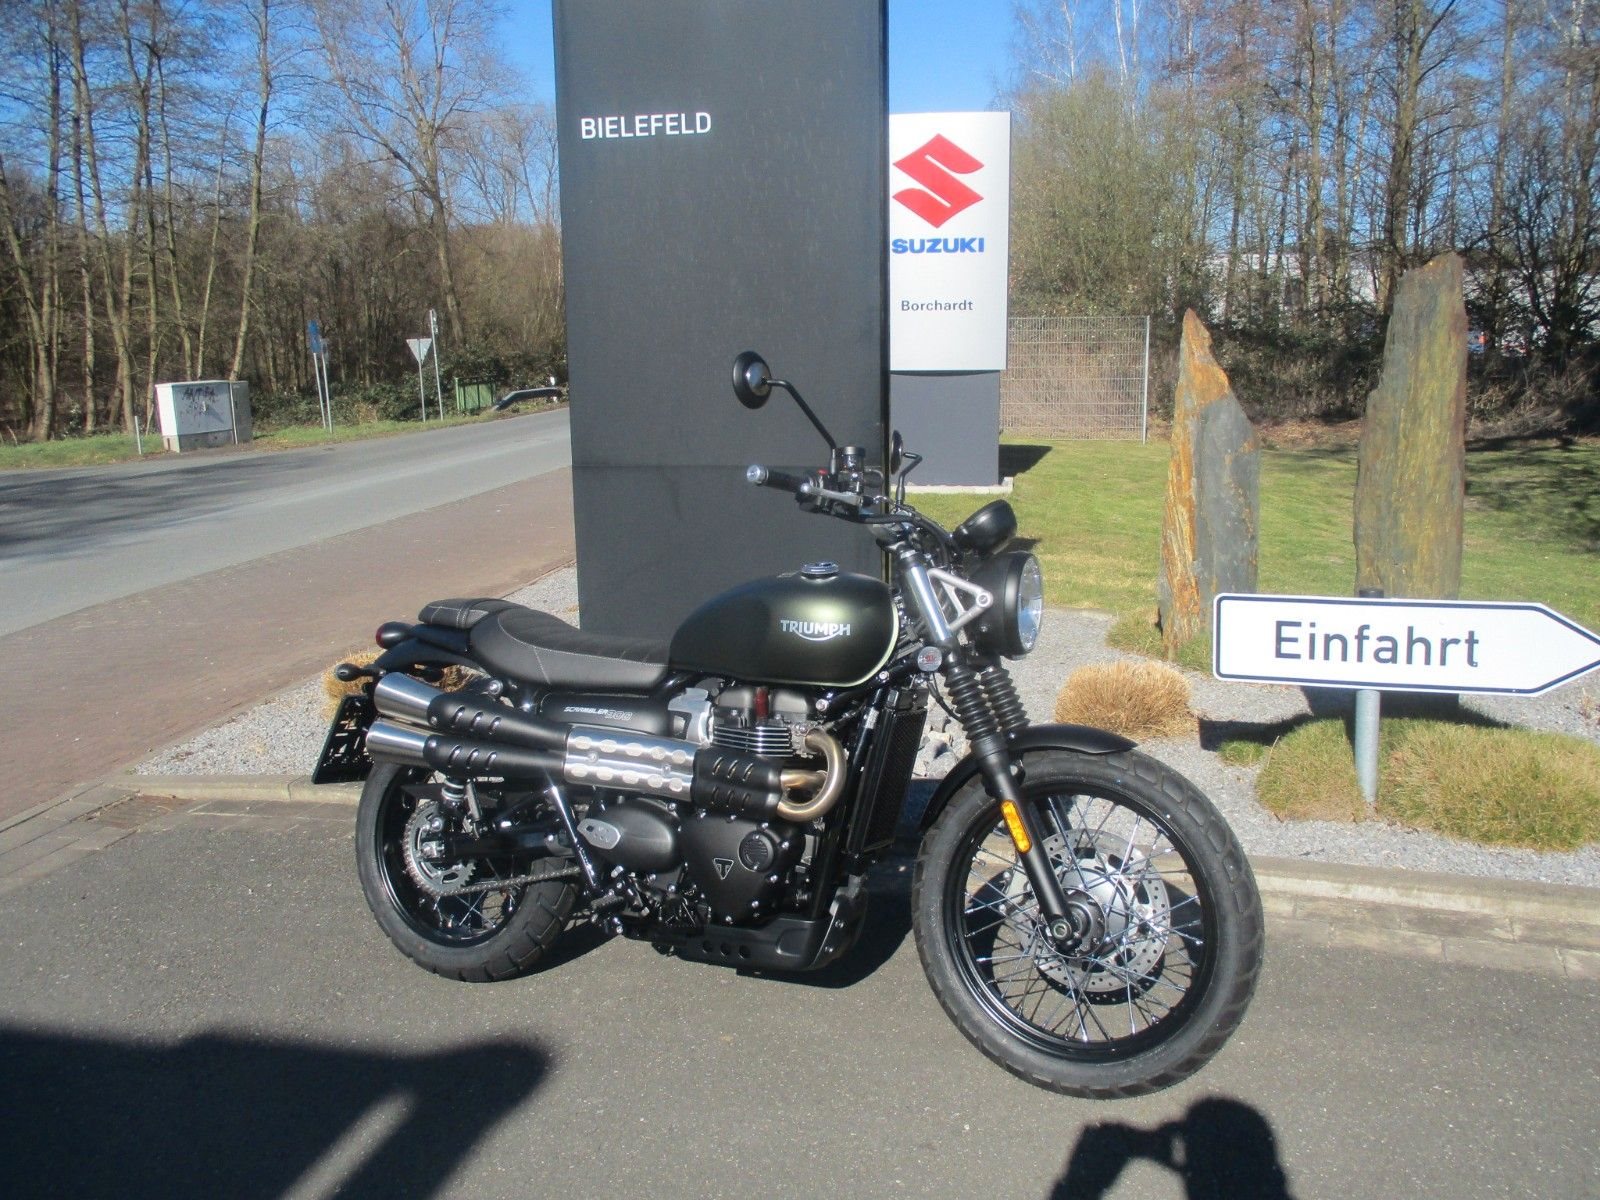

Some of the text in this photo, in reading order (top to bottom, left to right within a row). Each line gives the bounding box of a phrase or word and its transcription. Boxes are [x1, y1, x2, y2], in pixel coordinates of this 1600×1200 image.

[580, 111, 712, 140] BIELEFELD
[891, 237, 985, 254] SUZUKI
[901, 299, 974, 312] Borchardt
[780, 619, 851, 641] TRIUMPH
[1274, 619, 1480, 668] Einfahrt
